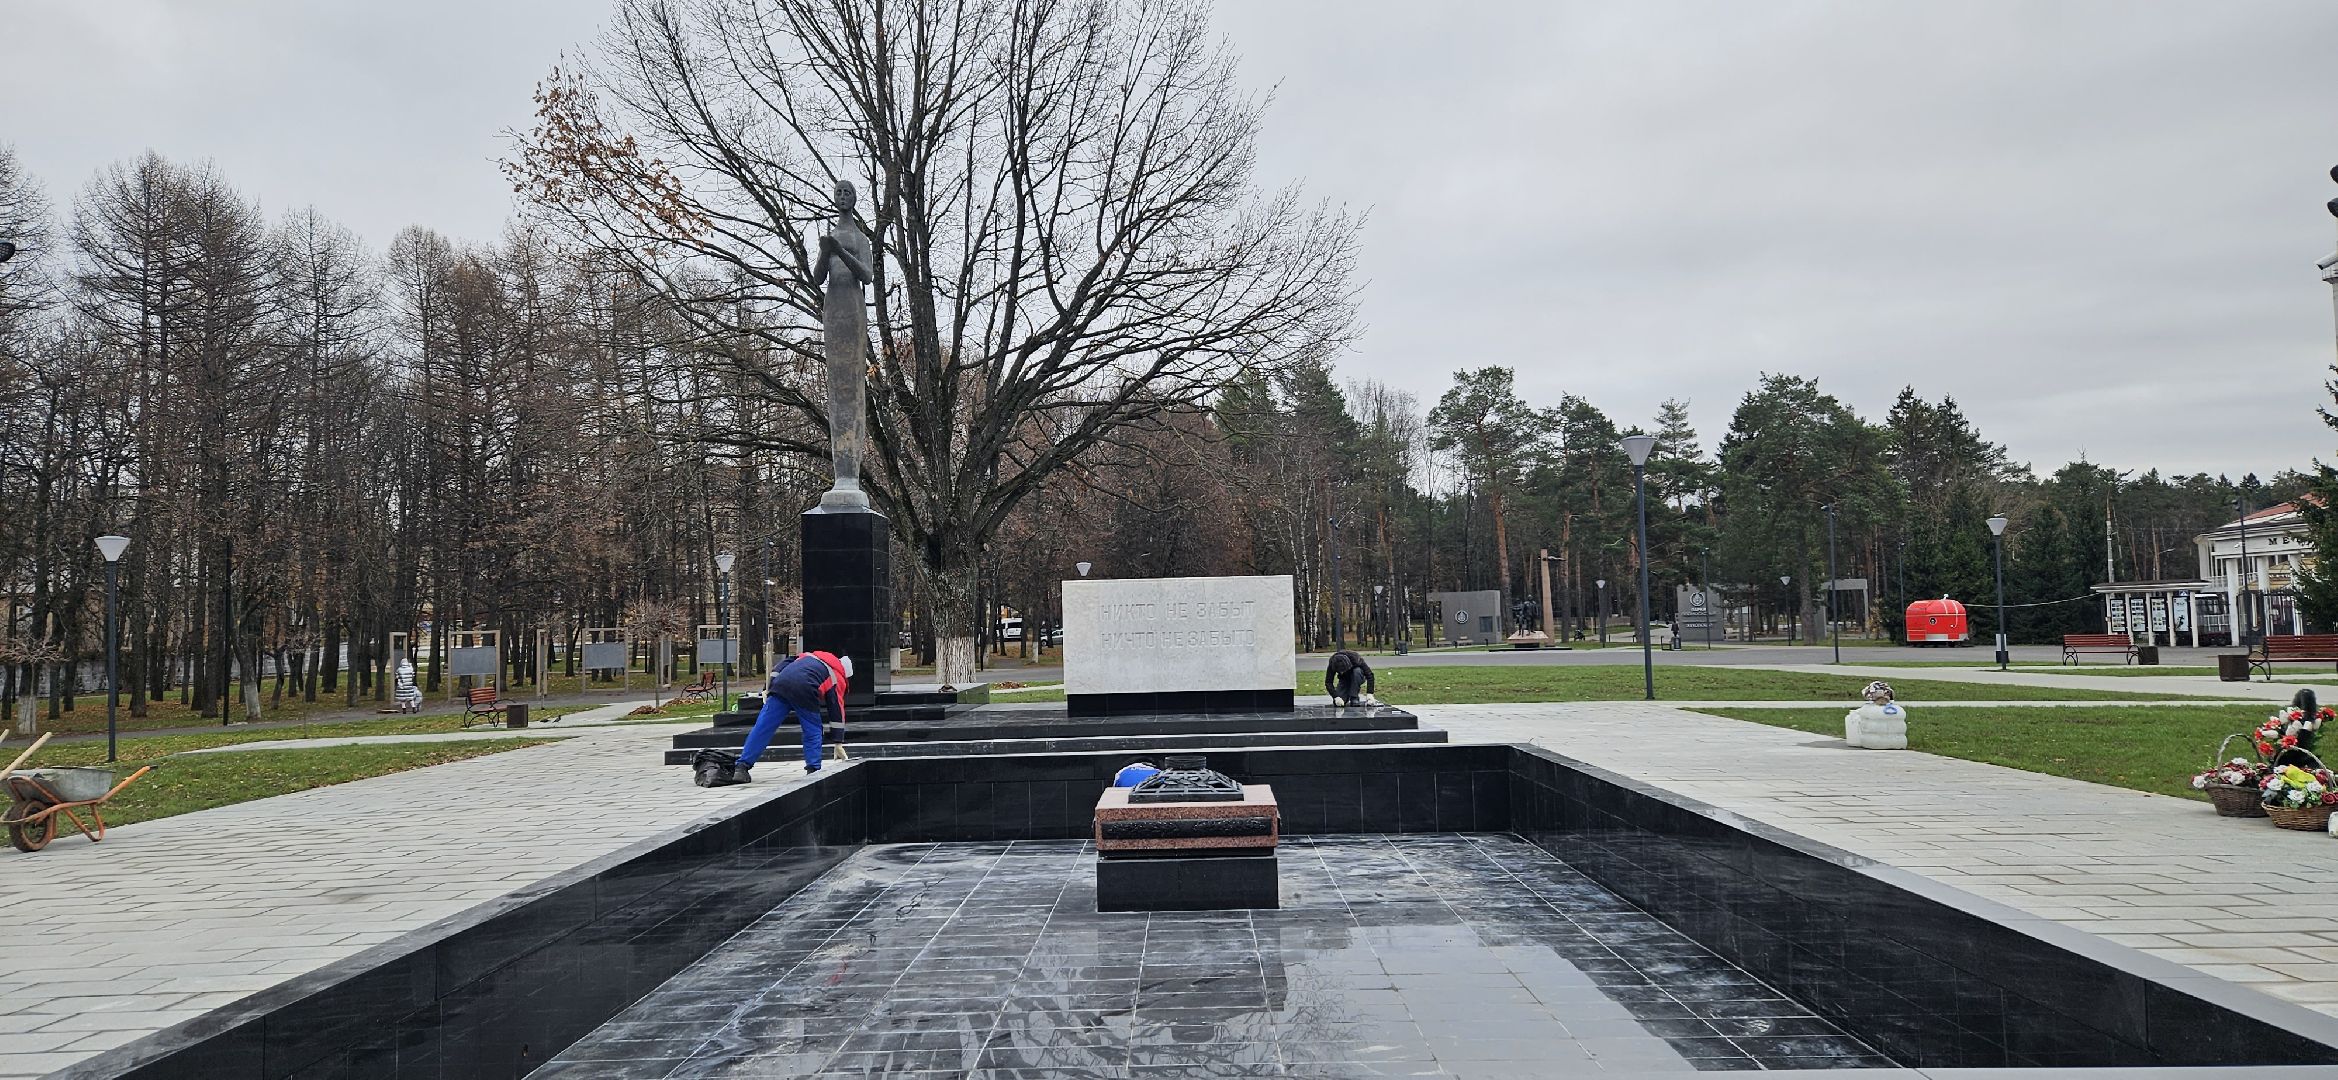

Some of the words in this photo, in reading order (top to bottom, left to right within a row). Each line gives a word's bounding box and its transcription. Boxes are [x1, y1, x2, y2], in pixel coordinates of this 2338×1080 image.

[1101, 603, 1156, 621] НИКТО
[1166, 602, 1188, 620] НЕ
[1196, 601, 1255, 620] ЗАБЫТ
[1101, 631, 1156, 649] НИЧТО
[1161, 630, 1184, 649] НЕ
[1188, 629, 1256, 648] ЗАБЫТО
